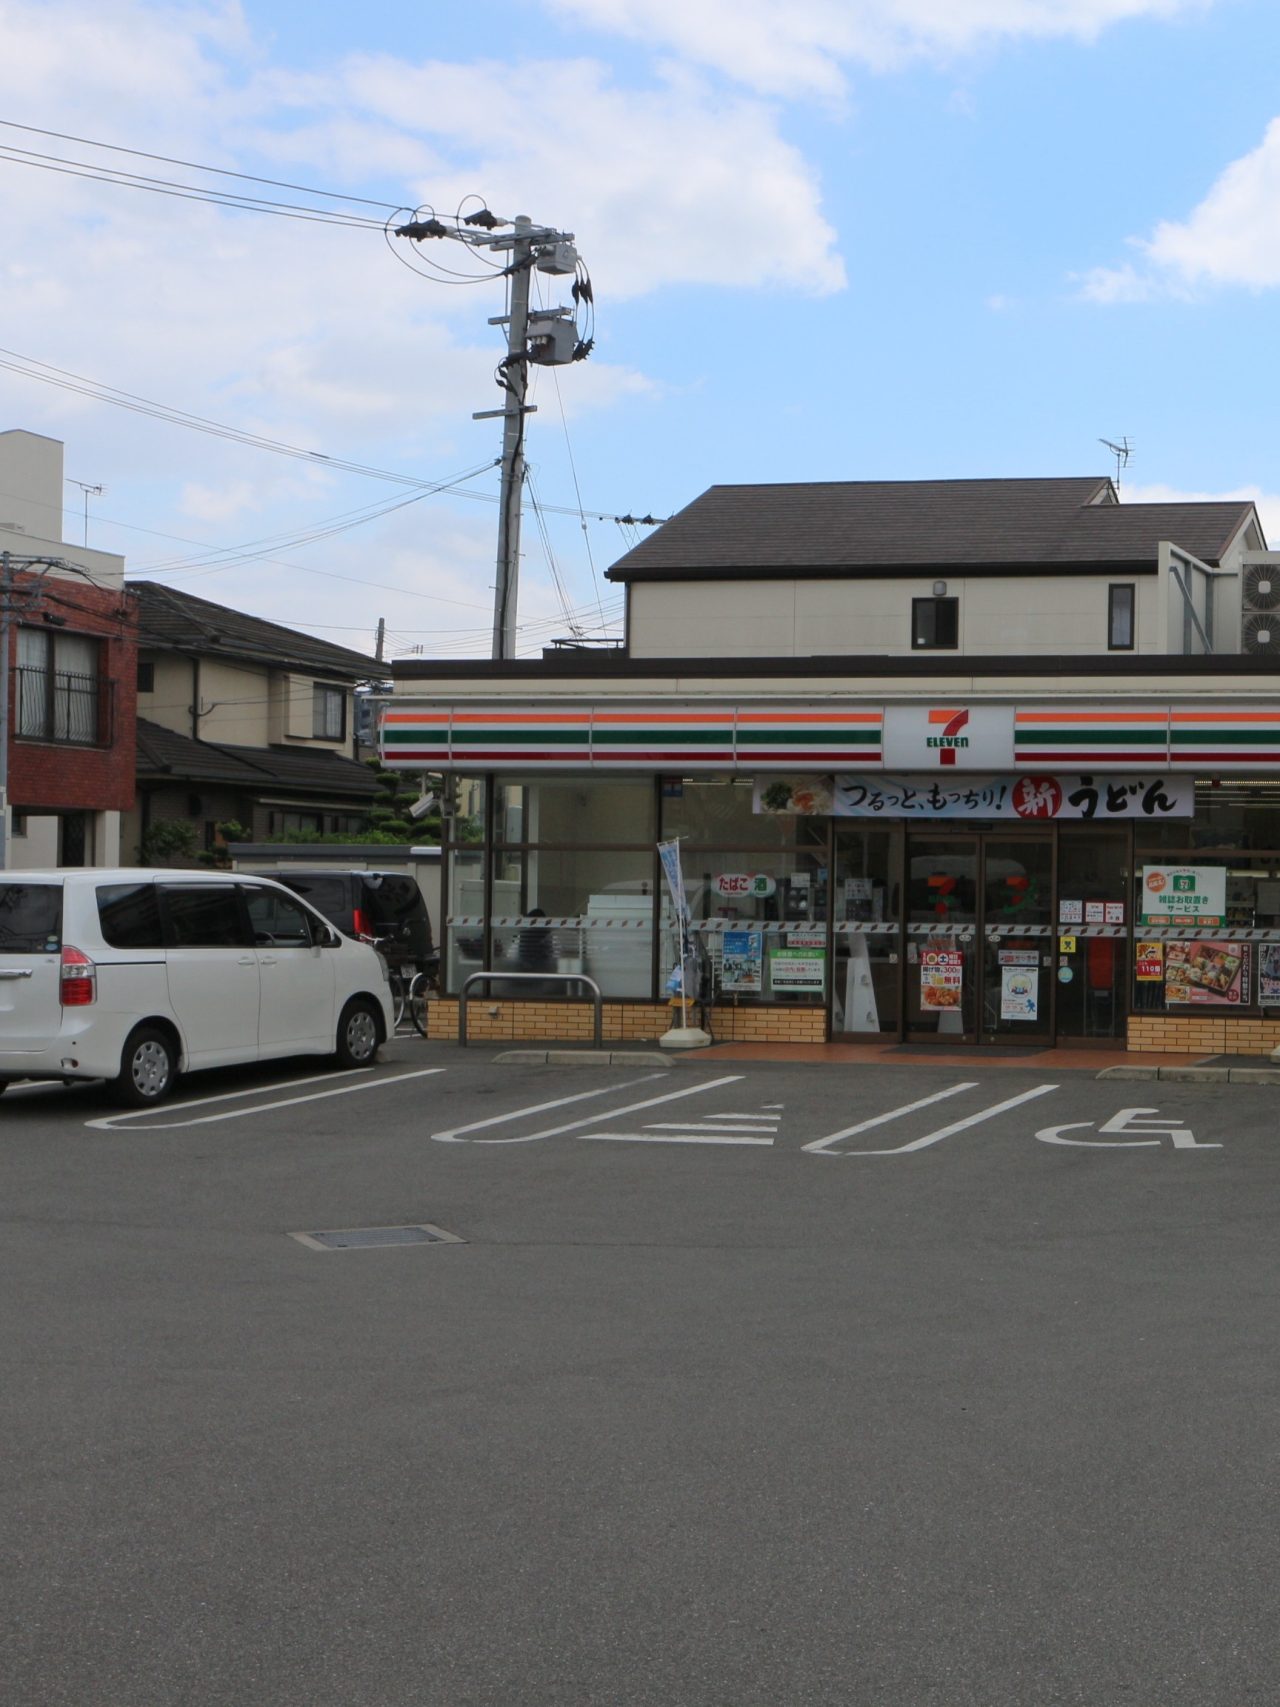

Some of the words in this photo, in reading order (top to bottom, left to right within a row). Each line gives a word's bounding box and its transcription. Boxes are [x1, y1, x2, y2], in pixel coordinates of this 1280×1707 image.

[928, 709, 968, 765] 7
[1068, 776, 1177, 818] うどん
[719, 877, 748, 891] たばこ
[754, 877, 767, 891] 酒
